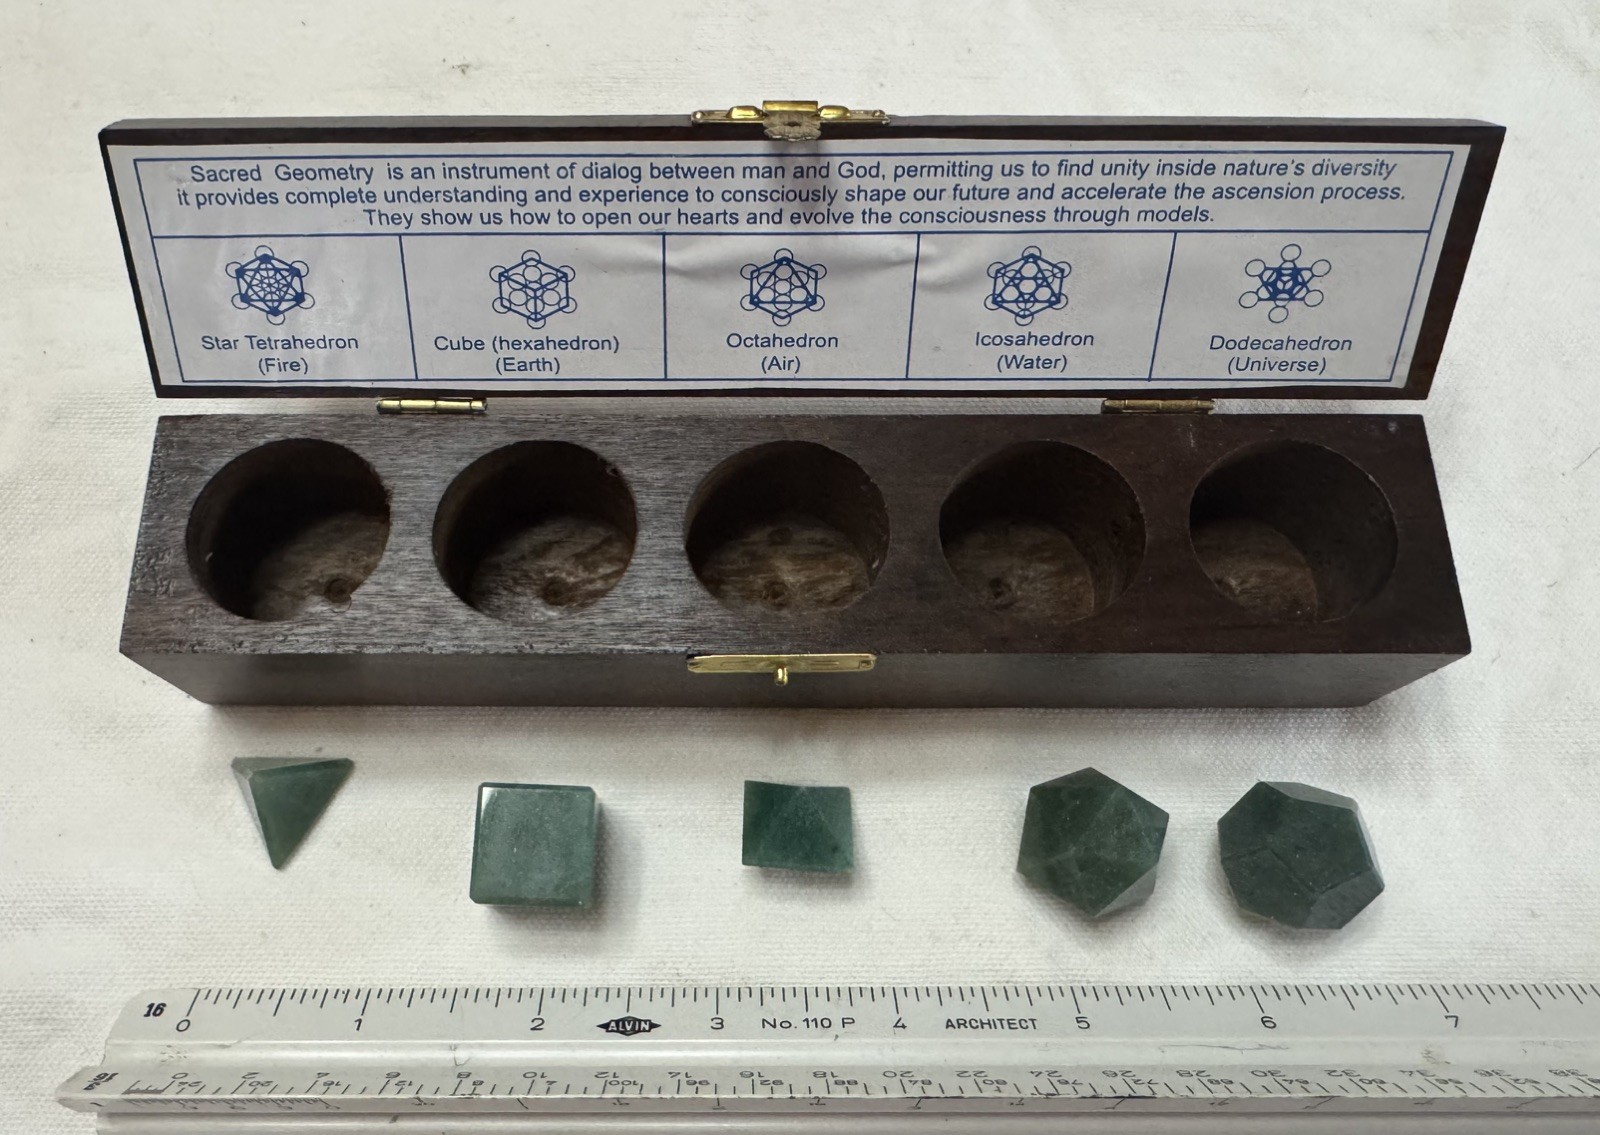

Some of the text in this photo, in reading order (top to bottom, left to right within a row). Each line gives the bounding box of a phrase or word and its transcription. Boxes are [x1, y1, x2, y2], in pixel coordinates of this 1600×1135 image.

[191, 159, 1397, 185] Sacred Geometry is an instrument of dialog between man and God, permitting us to find unity inside nature's diversity
[177, 182, 1404, 210] it provides complete understanding and experience to consciously shape our future and accelerate the ascension process.
[363, 205, 1214, 229] They show us how to open our hearts and evolve the consciousness through models.
[201, 335, 359, 350] Star Tetrahedron
[434, 336, 619, 354] Cube (hexahedron)
[726, 333, 838, 348] Octahedron
[976, 331, 1094, 346] Icosahedron
[1210, 335, 1352, 351] Dodecahedron
[259, 357, 308, 376] (Fire)
[496, 357, 560, 375] (Earth)
[761, 356, 800, 374] (Air)
[997, 355, 1067, 373] (Water)
[1228, 357, 1326, 375] (Universe)
[143, 1003, 167, 1017] 16
[176, 1019, 191, 1032] 0
[354, 1018, 362, 1031] 1
[530, 1018, 545, 1031] 2
[607, 1020, 651, 1031] ALVIN
[711, 1017, 724, 1030] 3
[842, 1017, 855, 1028] P
[893, 1017, 907, 1030] 4
[945, 1018, 1037, 1030] ARCHITECT
[1075, 1016, 1090, 1029] 5
[1261, 1016, 1277, 1029] 6
[1444, 1015, 1459, 1028] 7
